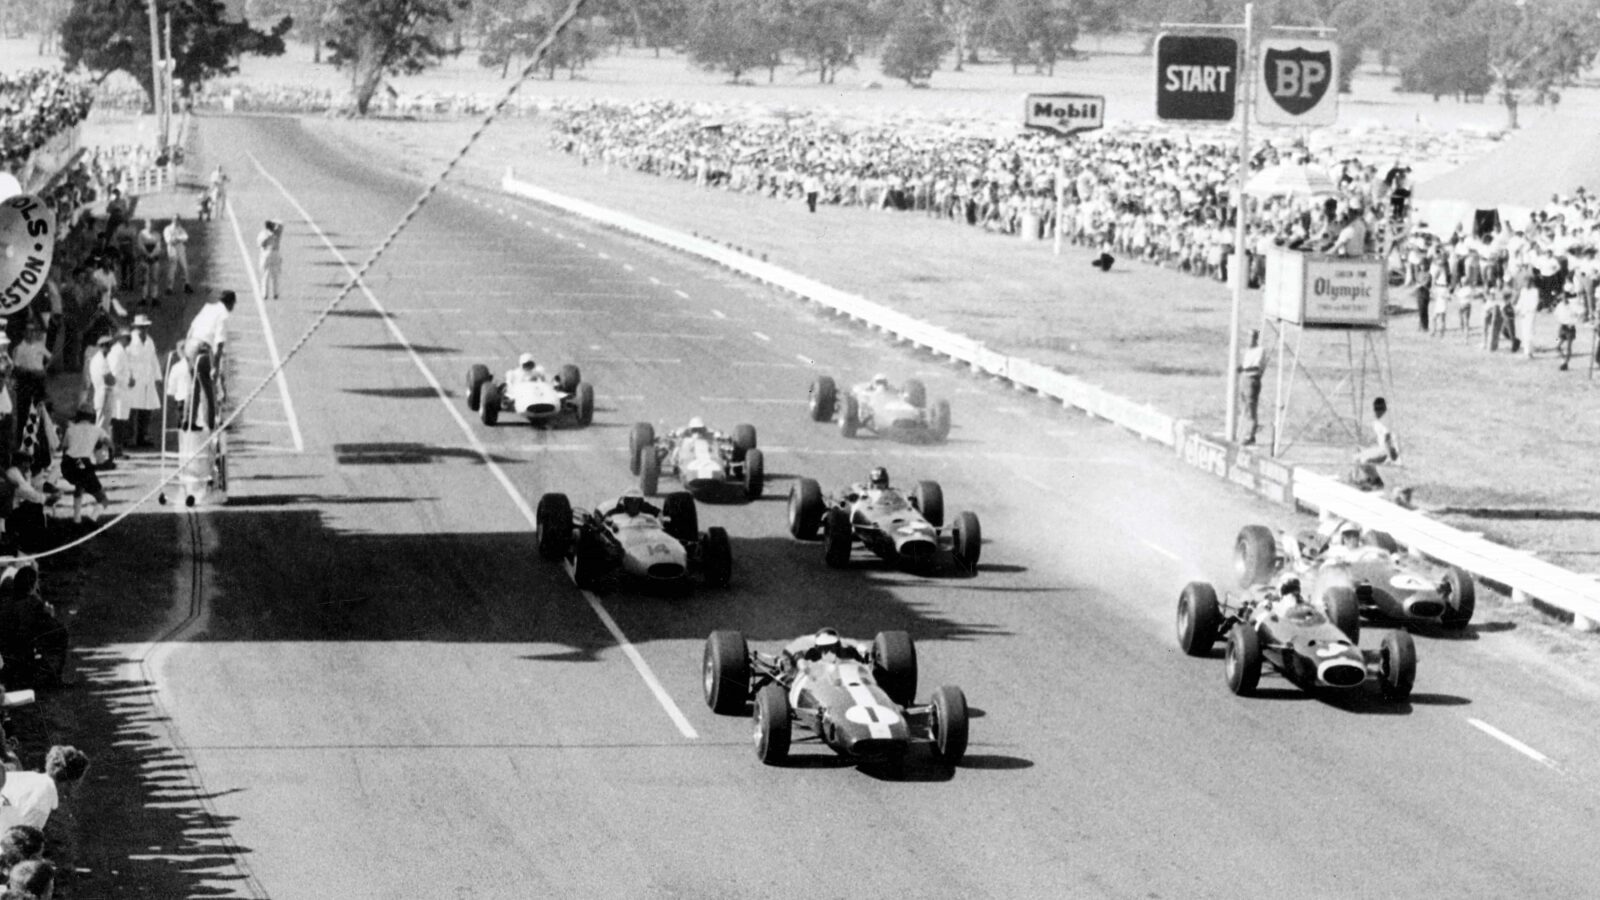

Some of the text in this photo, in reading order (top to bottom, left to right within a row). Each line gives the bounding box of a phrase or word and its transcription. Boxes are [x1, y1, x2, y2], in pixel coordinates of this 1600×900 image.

[1165, 65, 1231, 92] START
[1274, 59, 1325, 98] BP
[1034, 102, 1097, 118] Mobil
[1314, 277, 1372, 300] Olympic
[864, 706, 879, 723] 1
